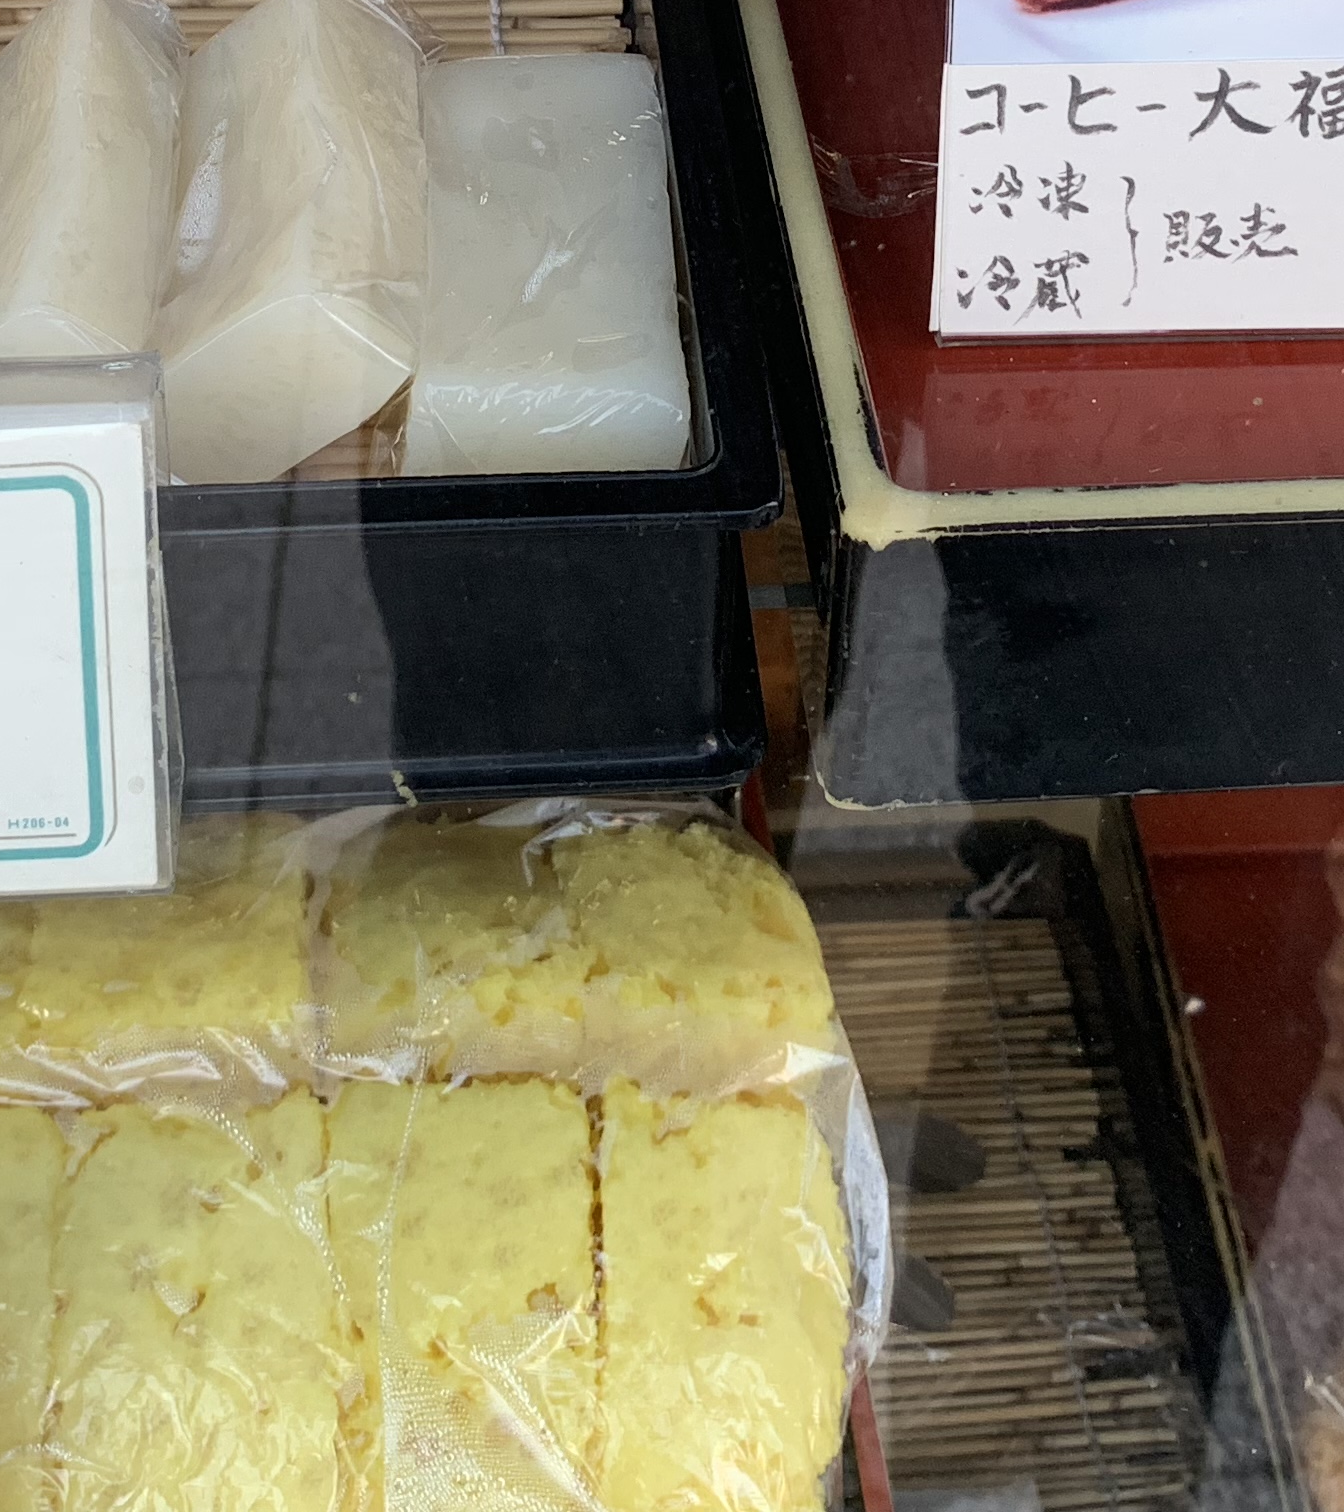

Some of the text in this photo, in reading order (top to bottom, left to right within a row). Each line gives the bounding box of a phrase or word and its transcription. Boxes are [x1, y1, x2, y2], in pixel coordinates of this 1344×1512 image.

[969, 160, 1090, 219] 冷凍
[1162, 202, 1300, 265] 販売
[955, 250, 1091, 321] 冷蔵
